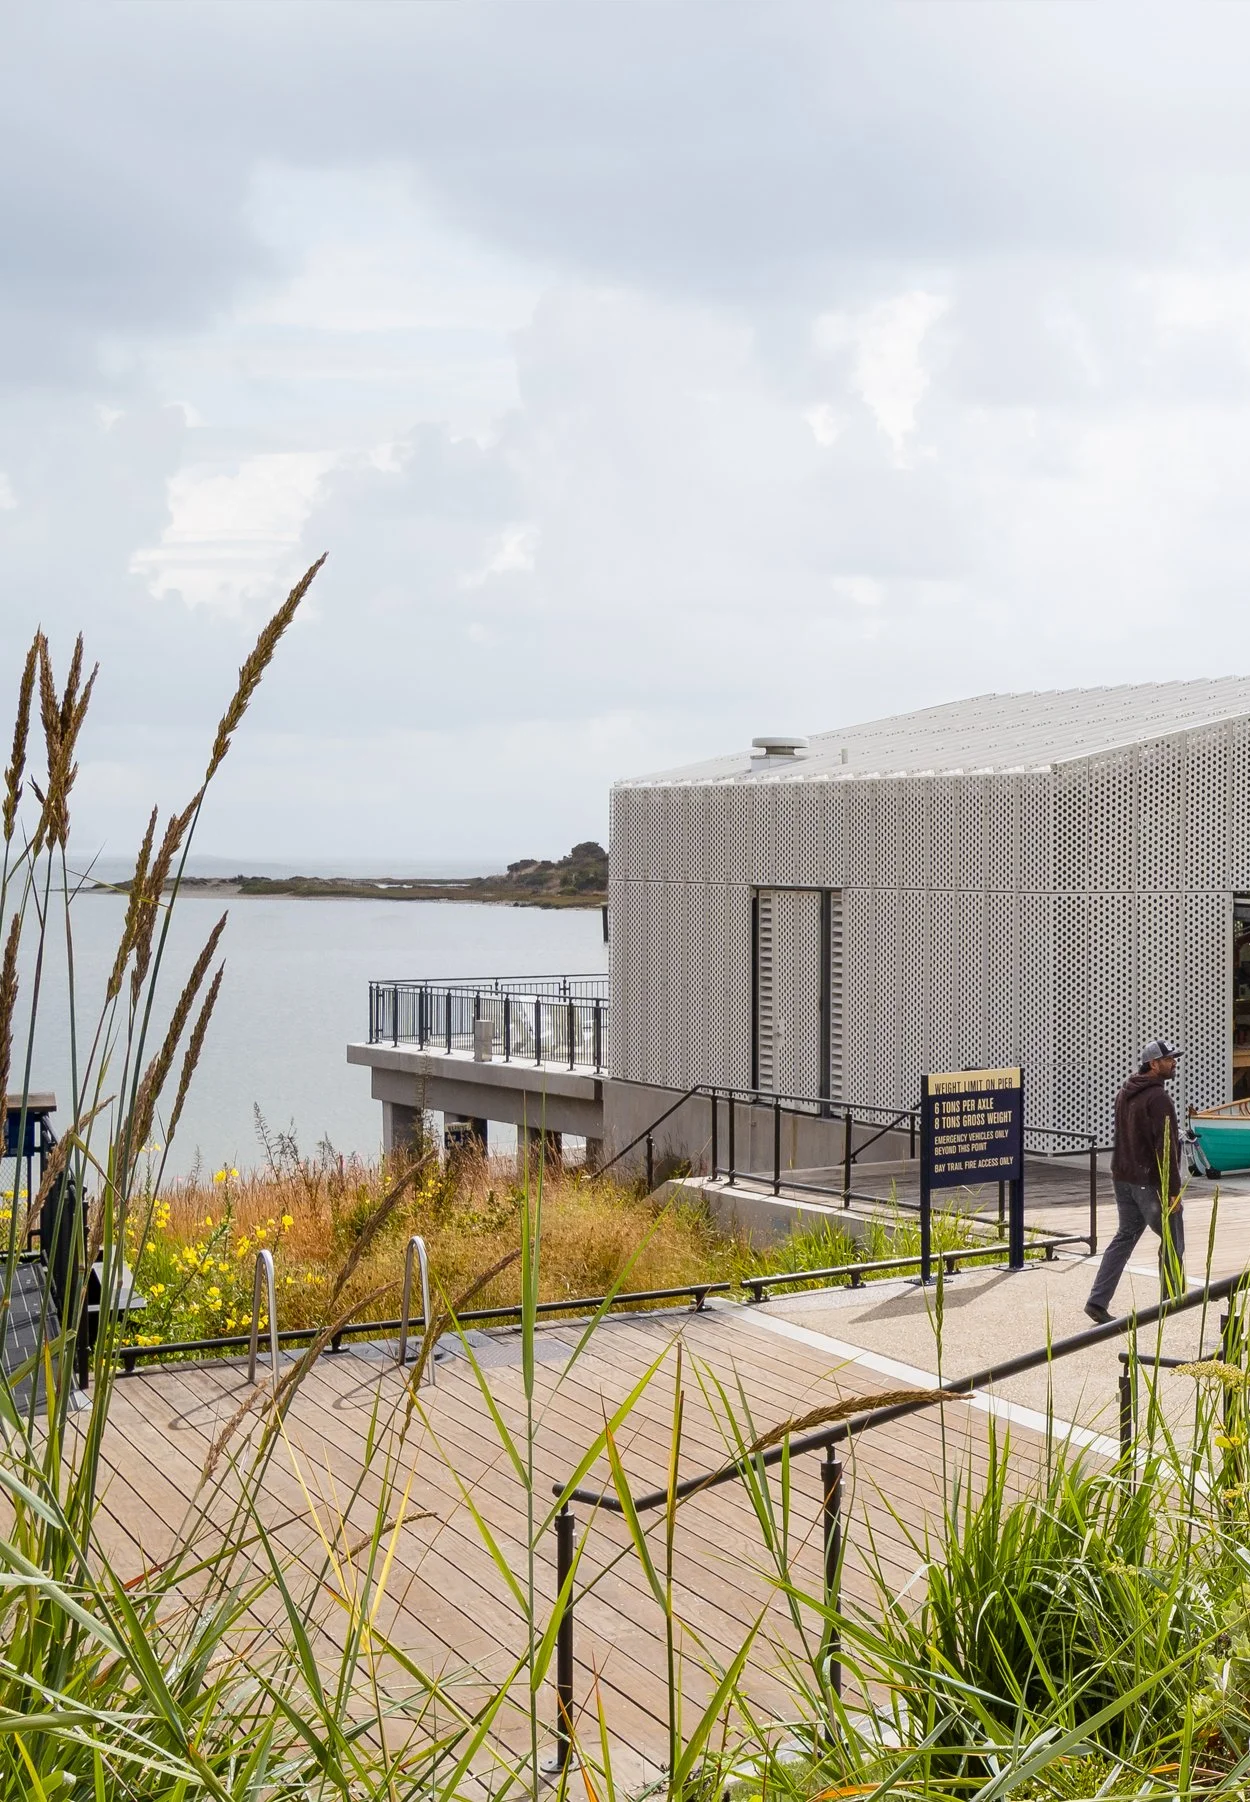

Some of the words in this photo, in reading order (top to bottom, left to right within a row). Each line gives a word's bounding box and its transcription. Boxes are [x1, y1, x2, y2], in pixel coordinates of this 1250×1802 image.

[934, 1081, 961, 1095] WEIGHT
[964, 1079, 983, 1093] LIMIT
[986, 1078, 995, 1090] ON
[998, 1077, 1013, 1089] PIER
[934, 1102, 939, 1115] 6
[942, 1100, 960, 1114] TONS
[962, 1099, 975, 1112] PER
[977, 1097, 994, 1111] AXLE
[934, 1117, 939, 1130] 8
[942, 1115, 960, 1129] TONS
[962, 1113, 985, 1127] GROSS
[987, 1110, 1013, 1125] WEIGHT
[934, 1133, 968, 1145] EMERGENCY
[968, 1131, 994, 1141] VEHICLES
[994, 1129, 1009, 1139] ONLY
[934, 1145, 957, 1156] BEYOND
[958, 1143, 970, 1154] THIS
[971, 1142, 988, 1152] POINT
[934, 1163, 945, 1174] BAY
[947, 1161, 964, 1172] TRAIL
[964, 1160, 977, 1171] FIRE
[978, 1157, 998, 1168] ACCESS
[999, 1156, 1014, 1166] ONLY
